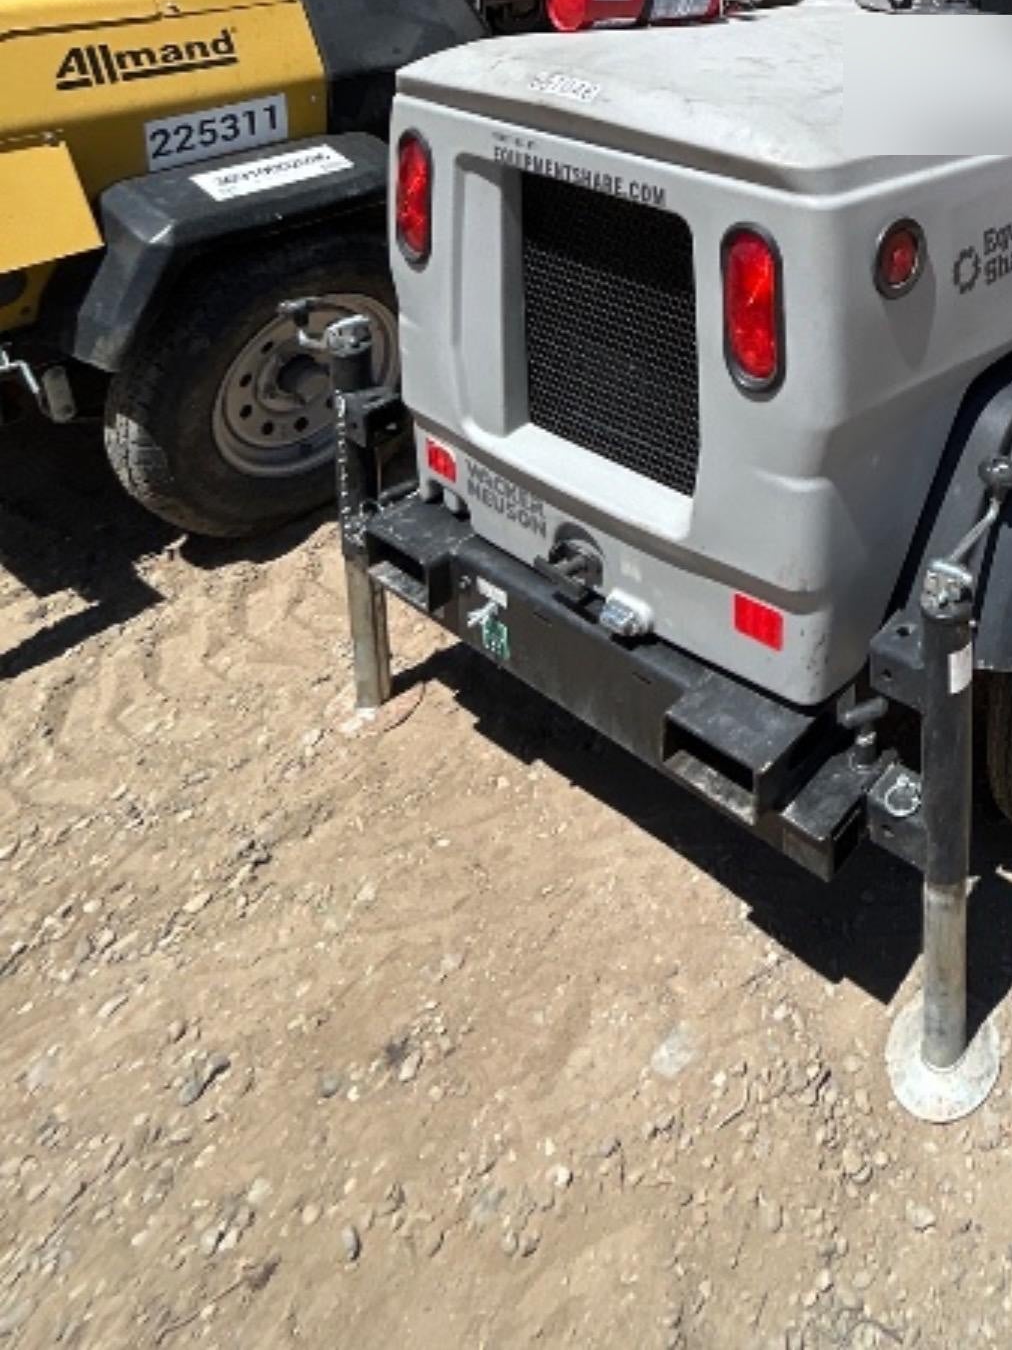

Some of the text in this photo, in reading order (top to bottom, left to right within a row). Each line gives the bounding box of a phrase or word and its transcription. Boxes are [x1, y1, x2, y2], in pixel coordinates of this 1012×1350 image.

[56, 26, 236, 85] Allmand
[150, 103, 278, 160] 225311
[467, 481, 548, 539] NEUSON
